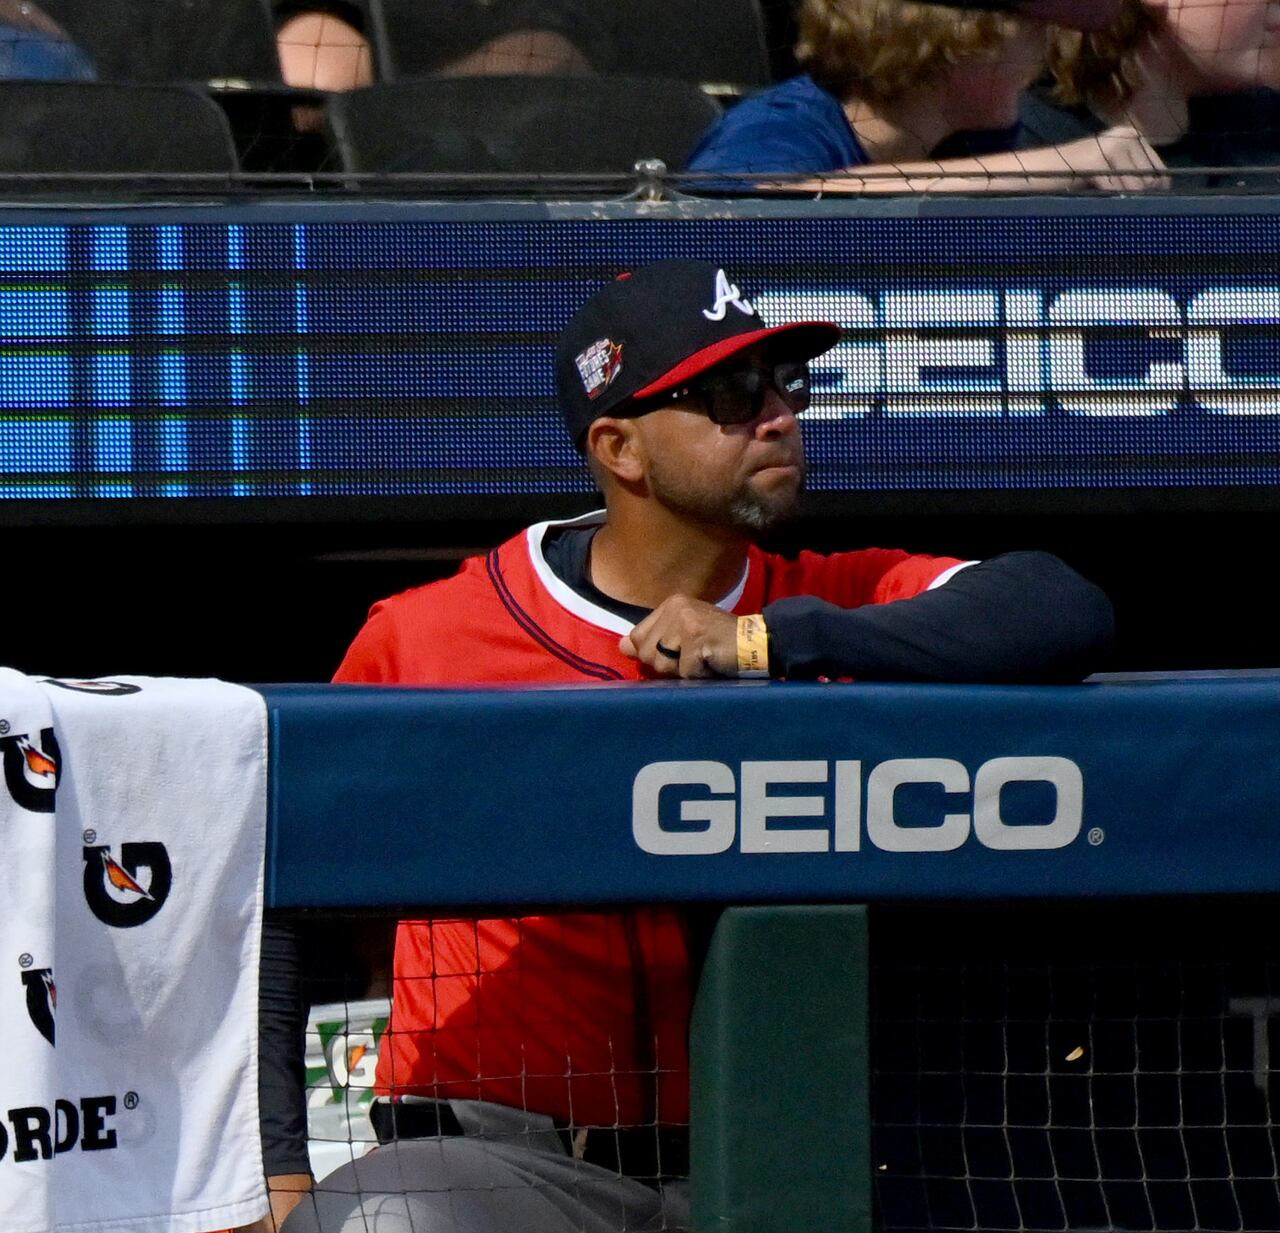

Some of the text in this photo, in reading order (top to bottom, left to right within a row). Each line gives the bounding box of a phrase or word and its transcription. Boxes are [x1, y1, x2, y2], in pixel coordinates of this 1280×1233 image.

[703, 269, 754, 321] A
[632, 755, 1084, 856] GEICO
[83, 841, 172, 928] G
